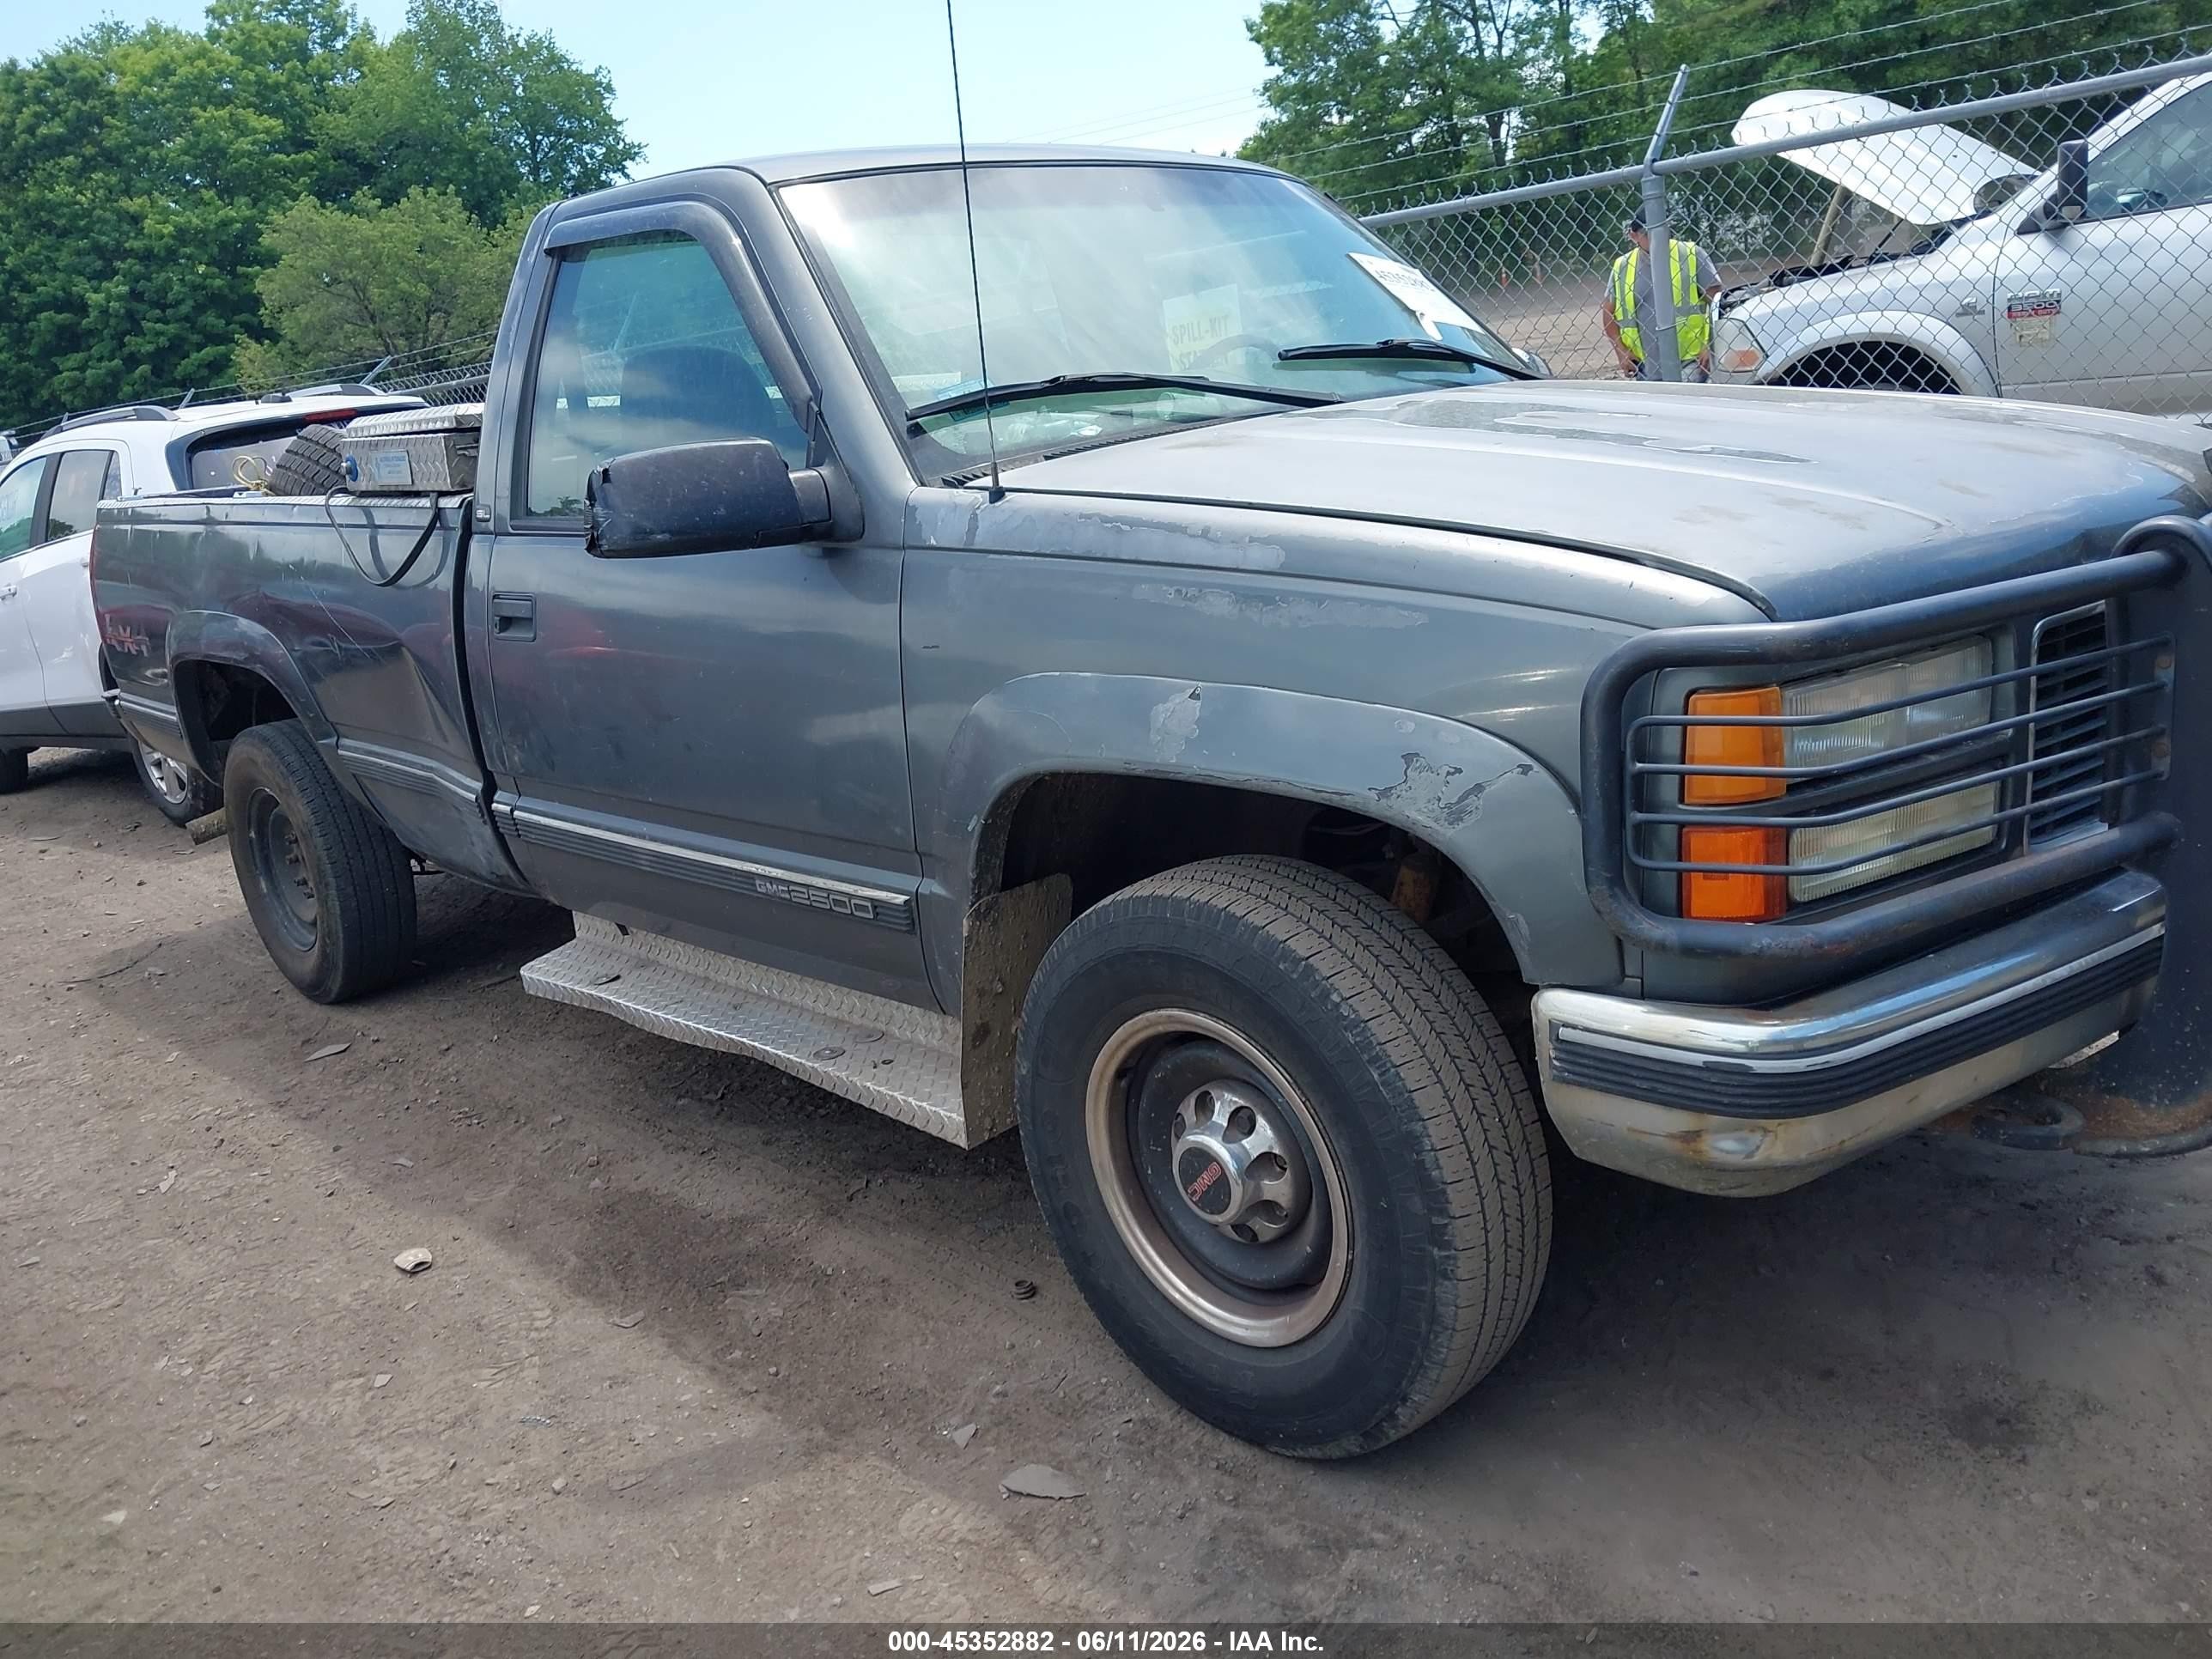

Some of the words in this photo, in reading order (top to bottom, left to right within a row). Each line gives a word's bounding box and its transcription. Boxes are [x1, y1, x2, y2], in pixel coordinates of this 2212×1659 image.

[1171, 314, 1230, 344] SPILL-KIT
[476, 509, 490, 518] SL
[1188, 1161, 1222, 1202] GMC
